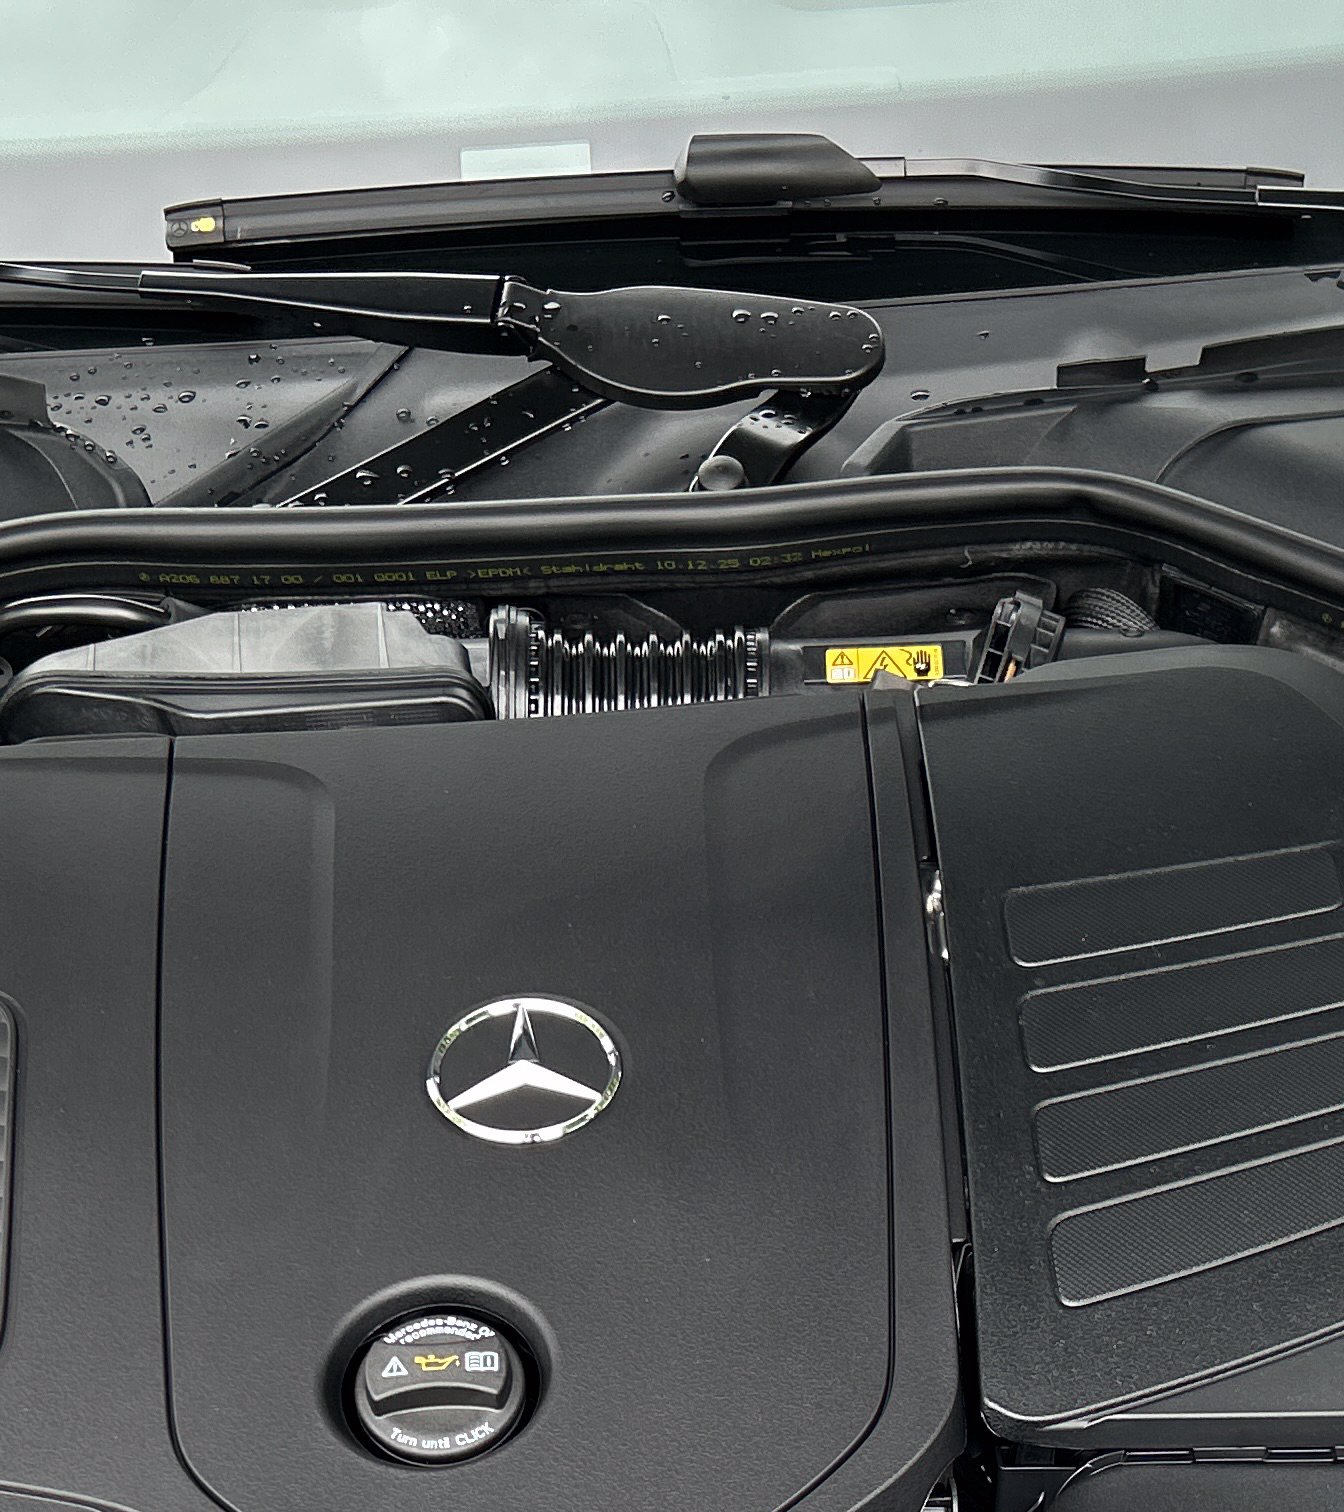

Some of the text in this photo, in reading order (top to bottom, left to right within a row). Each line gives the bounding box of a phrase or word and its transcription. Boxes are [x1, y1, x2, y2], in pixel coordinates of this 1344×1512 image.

[391, 1421, 495, 1450] Turn until CLICK
